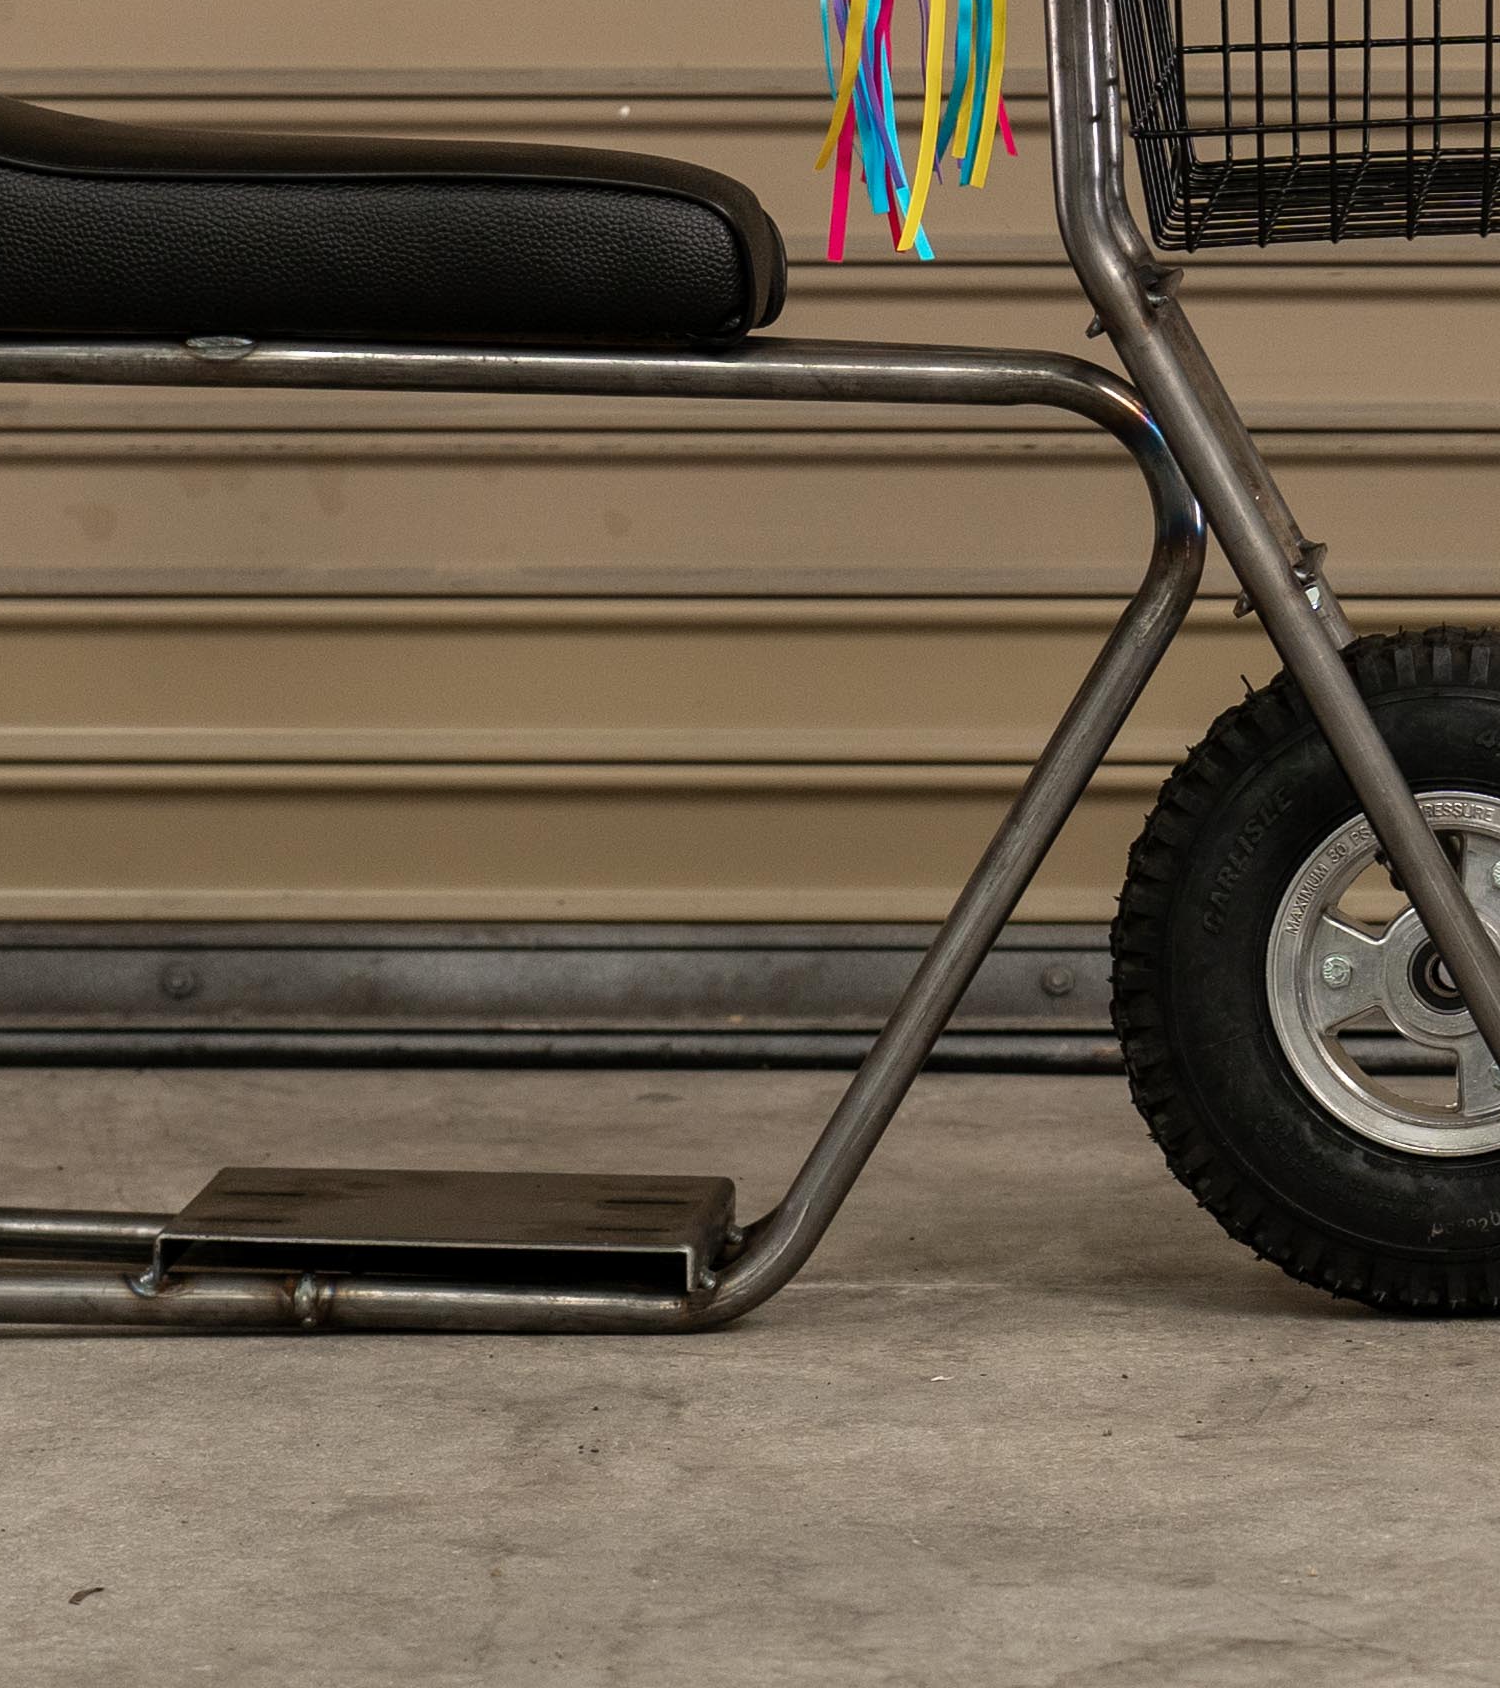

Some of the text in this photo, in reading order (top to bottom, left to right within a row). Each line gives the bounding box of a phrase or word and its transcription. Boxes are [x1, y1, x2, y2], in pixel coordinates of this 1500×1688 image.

[1202, 785, 1293, 935] CARLISLE
[1418, 802, 1496, 823] RESSURE
[1284, 825, 1377, 937] MAXIMUM 30 PS
